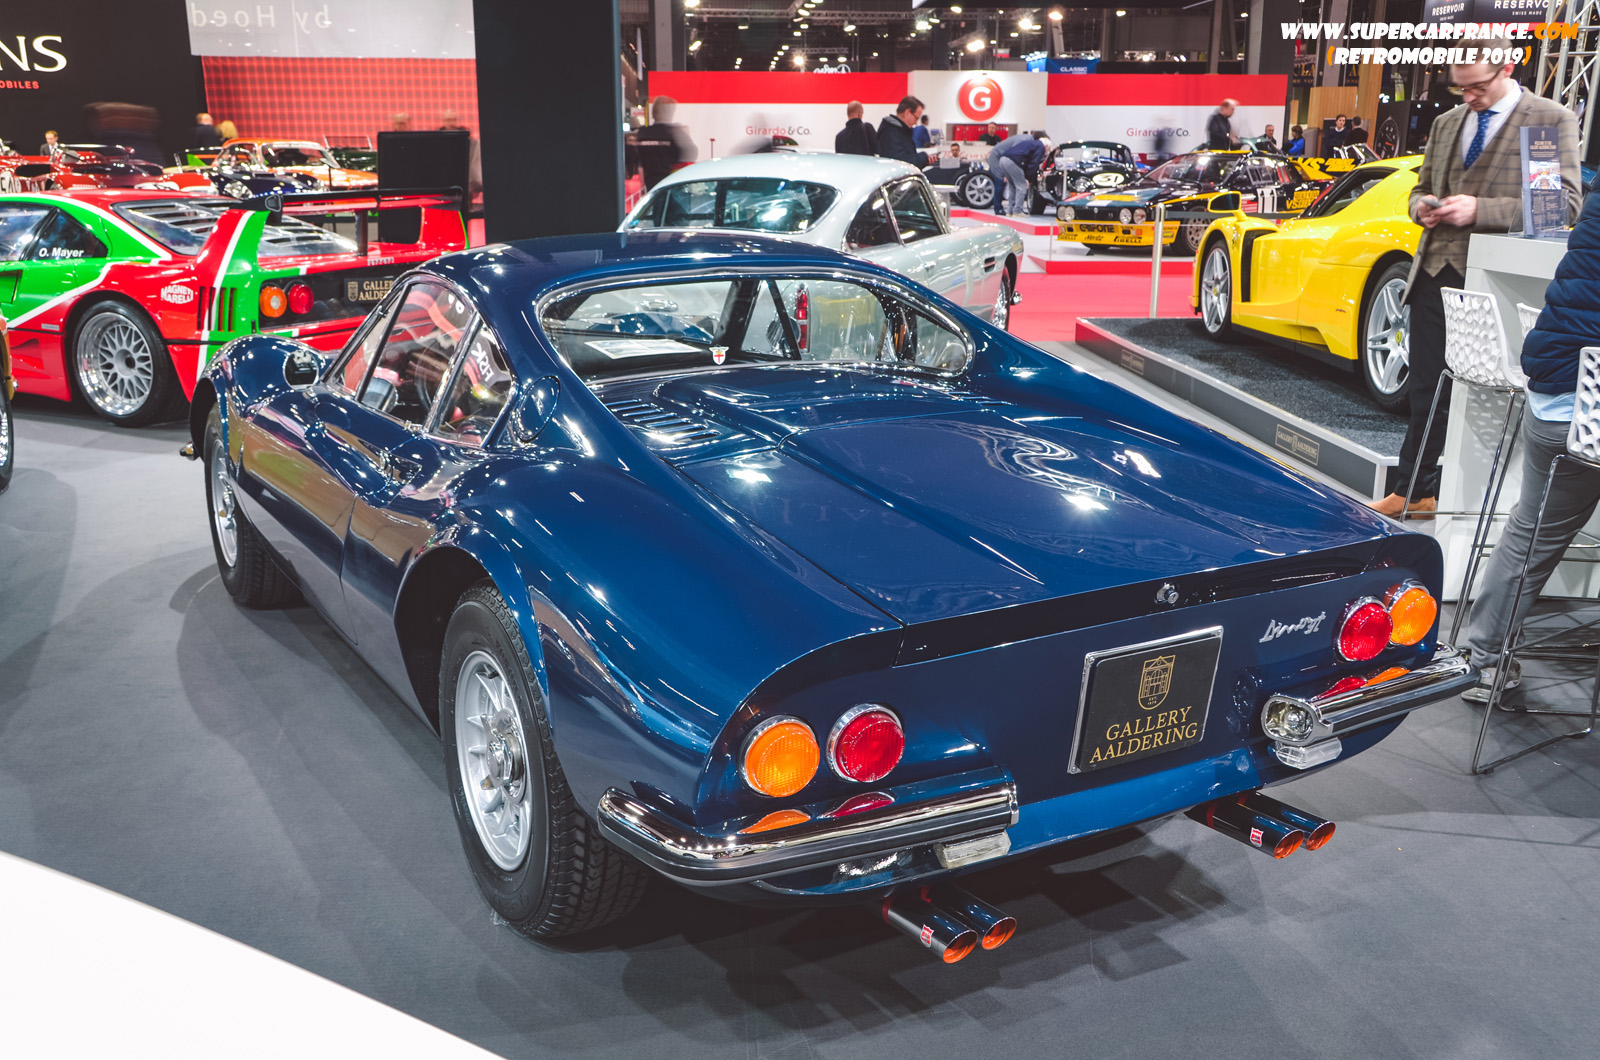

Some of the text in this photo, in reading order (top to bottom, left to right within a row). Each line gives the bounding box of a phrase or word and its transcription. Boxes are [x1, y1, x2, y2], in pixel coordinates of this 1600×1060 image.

[1432, 2, 1464, 16] RESERVOIR
[968, 86, 992, 112] G
[745, 125, 813, 136] Girardo & Co.
[1176, 127, 1191, 137] Co.
[38, 247, 85, 258] O. Mayer
[1106, 705, 1192, 741] GALLERY
[1089, 722, 1198, 764] AALDERING
